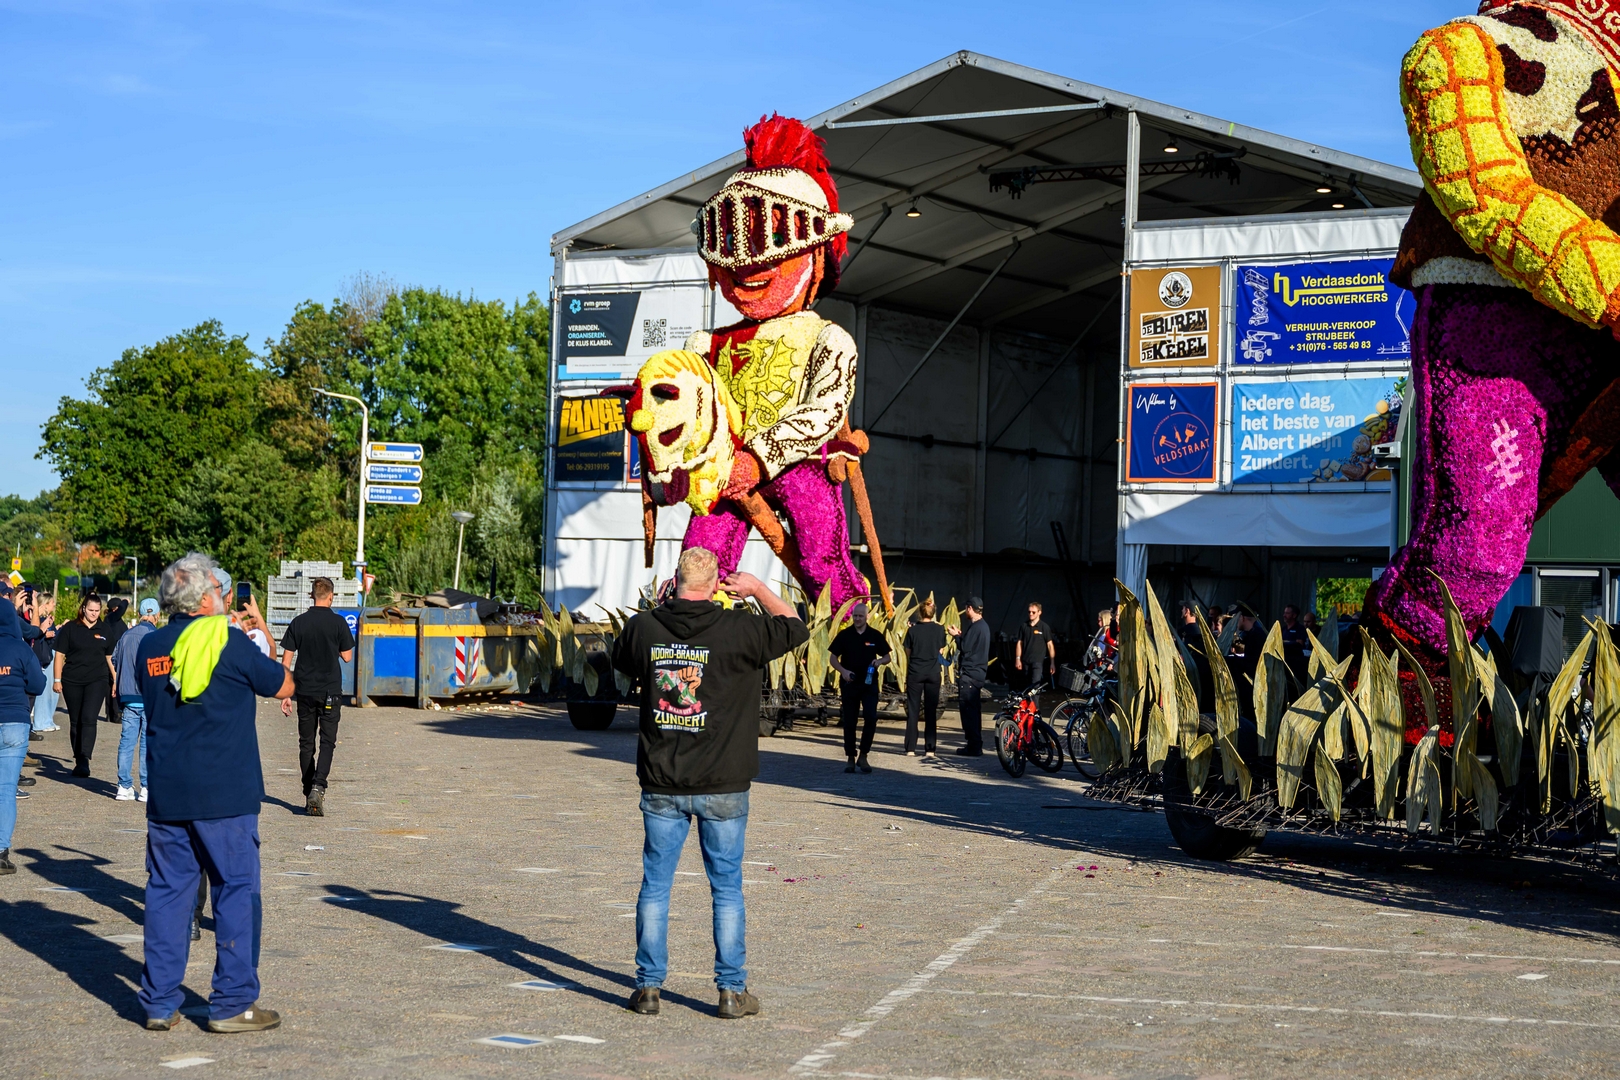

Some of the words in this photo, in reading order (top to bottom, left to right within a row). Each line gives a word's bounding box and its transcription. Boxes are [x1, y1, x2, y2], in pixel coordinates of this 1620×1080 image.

[1301, 272, 1384, 287] Verdaasdonk
[1302, 292, 1388, 306] HOOGWERKERS
[1153, 310, 1208, 335] BUREN
[1285, 320, 1376, 332] VERHUUR-VERKOOP
[1306, 332, 1356, 341] STRIJBEEK
[1152, 336, 1206, 360] KEREL
[1296, 342, 1326, 352] 31(0)76
[1333, 342, 1348, 350] 565
[1349, 341, 1359, 349] 49
[1361, 340, 1371, 349] 83
[1241, 394, 1294, 411] Iedere
[1300, 392, 1335, 412] dag,
[600, 421, 625, 435] LAT
[1241, 414, 1268, 431] het
[1273, 413, 1319, 430] beste
[1324, 414, 1355, 428] van
[1240, 434, 1294, 451] Albert
[1299, 432, 1342, 452] Heijn
[1154, 438, 1210, 465] VELDSTRAAT
[1240, 453, 1312, 471] Zundert.
[651, 647, 709, 664] NOORD-BRABANT
[653, 709, 708, 726] ZUNDERT
